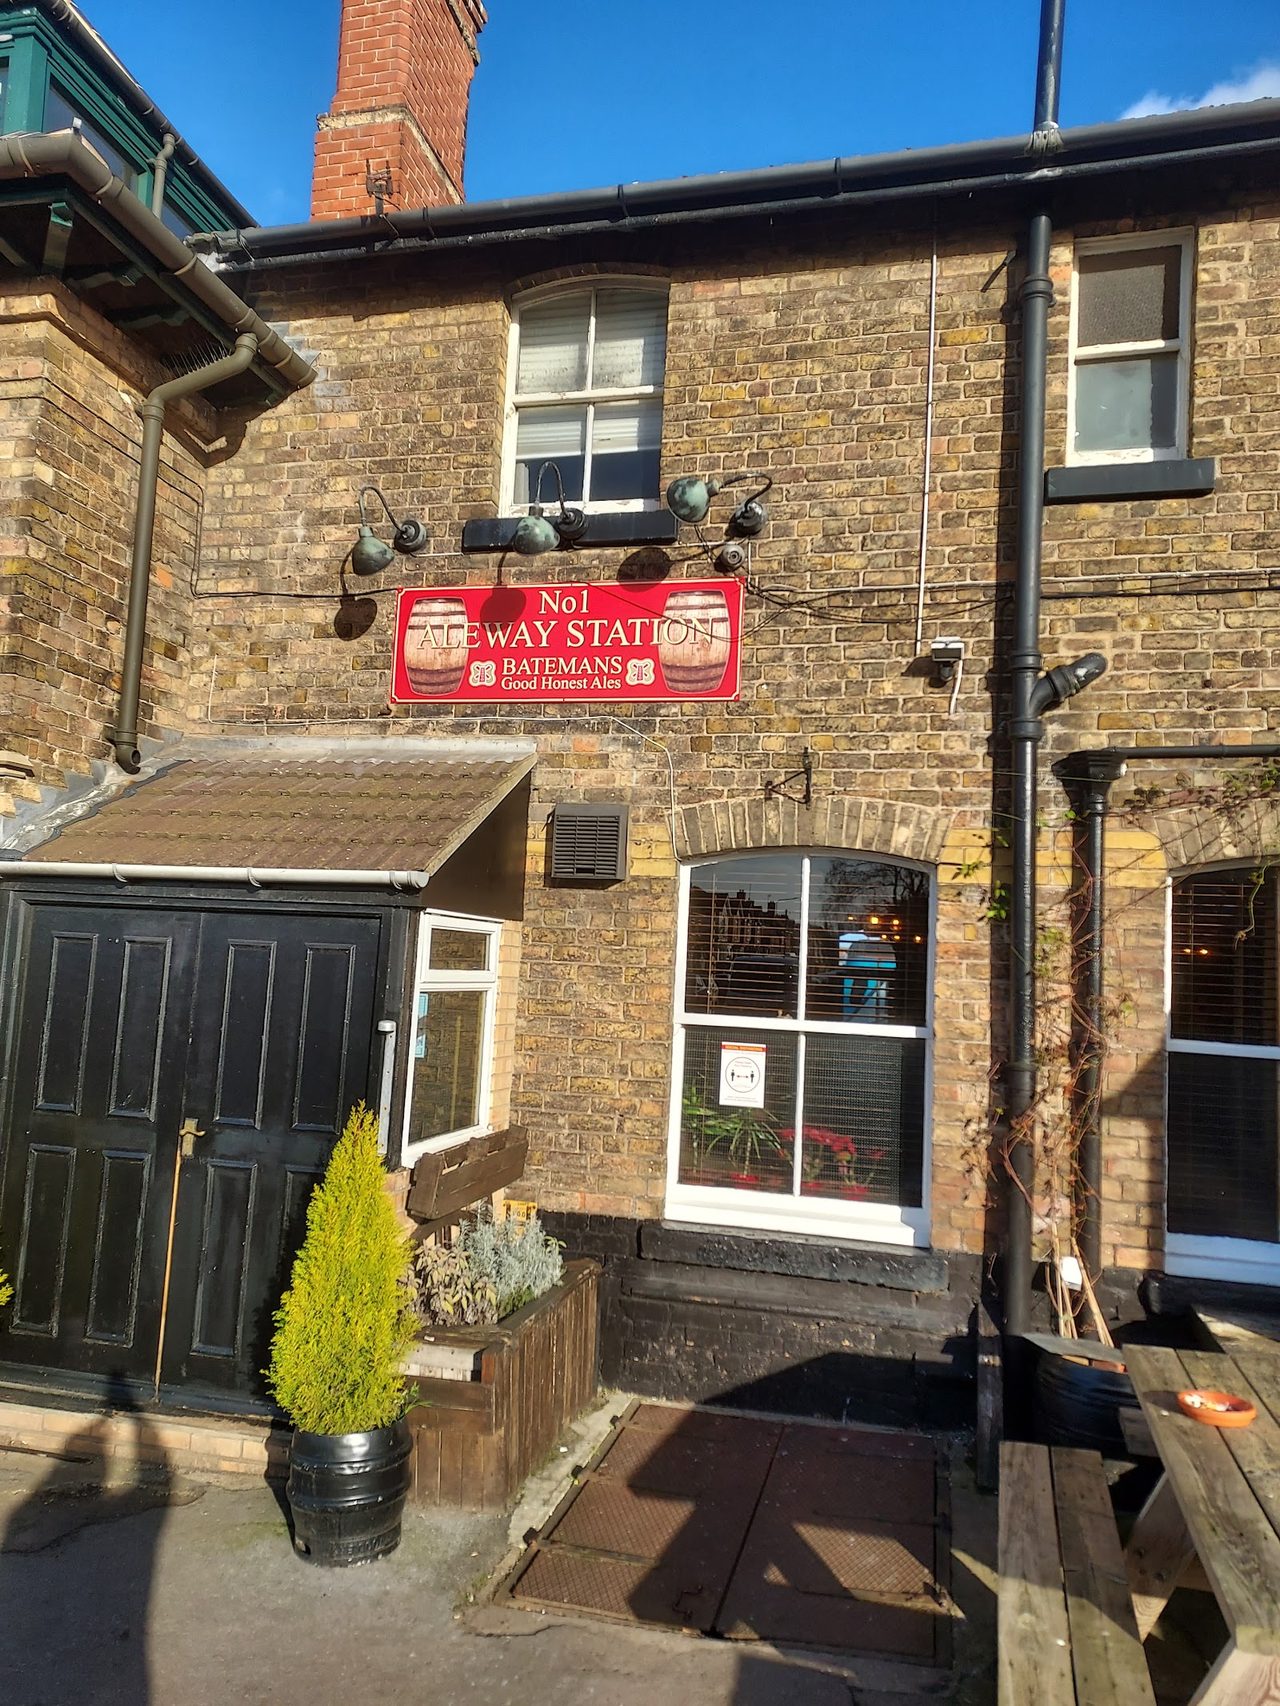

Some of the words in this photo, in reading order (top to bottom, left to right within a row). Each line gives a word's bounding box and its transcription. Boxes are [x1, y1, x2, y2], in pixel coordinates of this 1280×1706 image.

[538, 589, 590, 614] No1
[417, 620, 558, 649] ALEWAY
[566, 617, 713, 647] STATION
[501, 656, 623, 675] BATEMANS
[501, 676, 538, 690] Good
[541, 676, 588, 690] Honest
[590, 675, 621, 689] Ales
